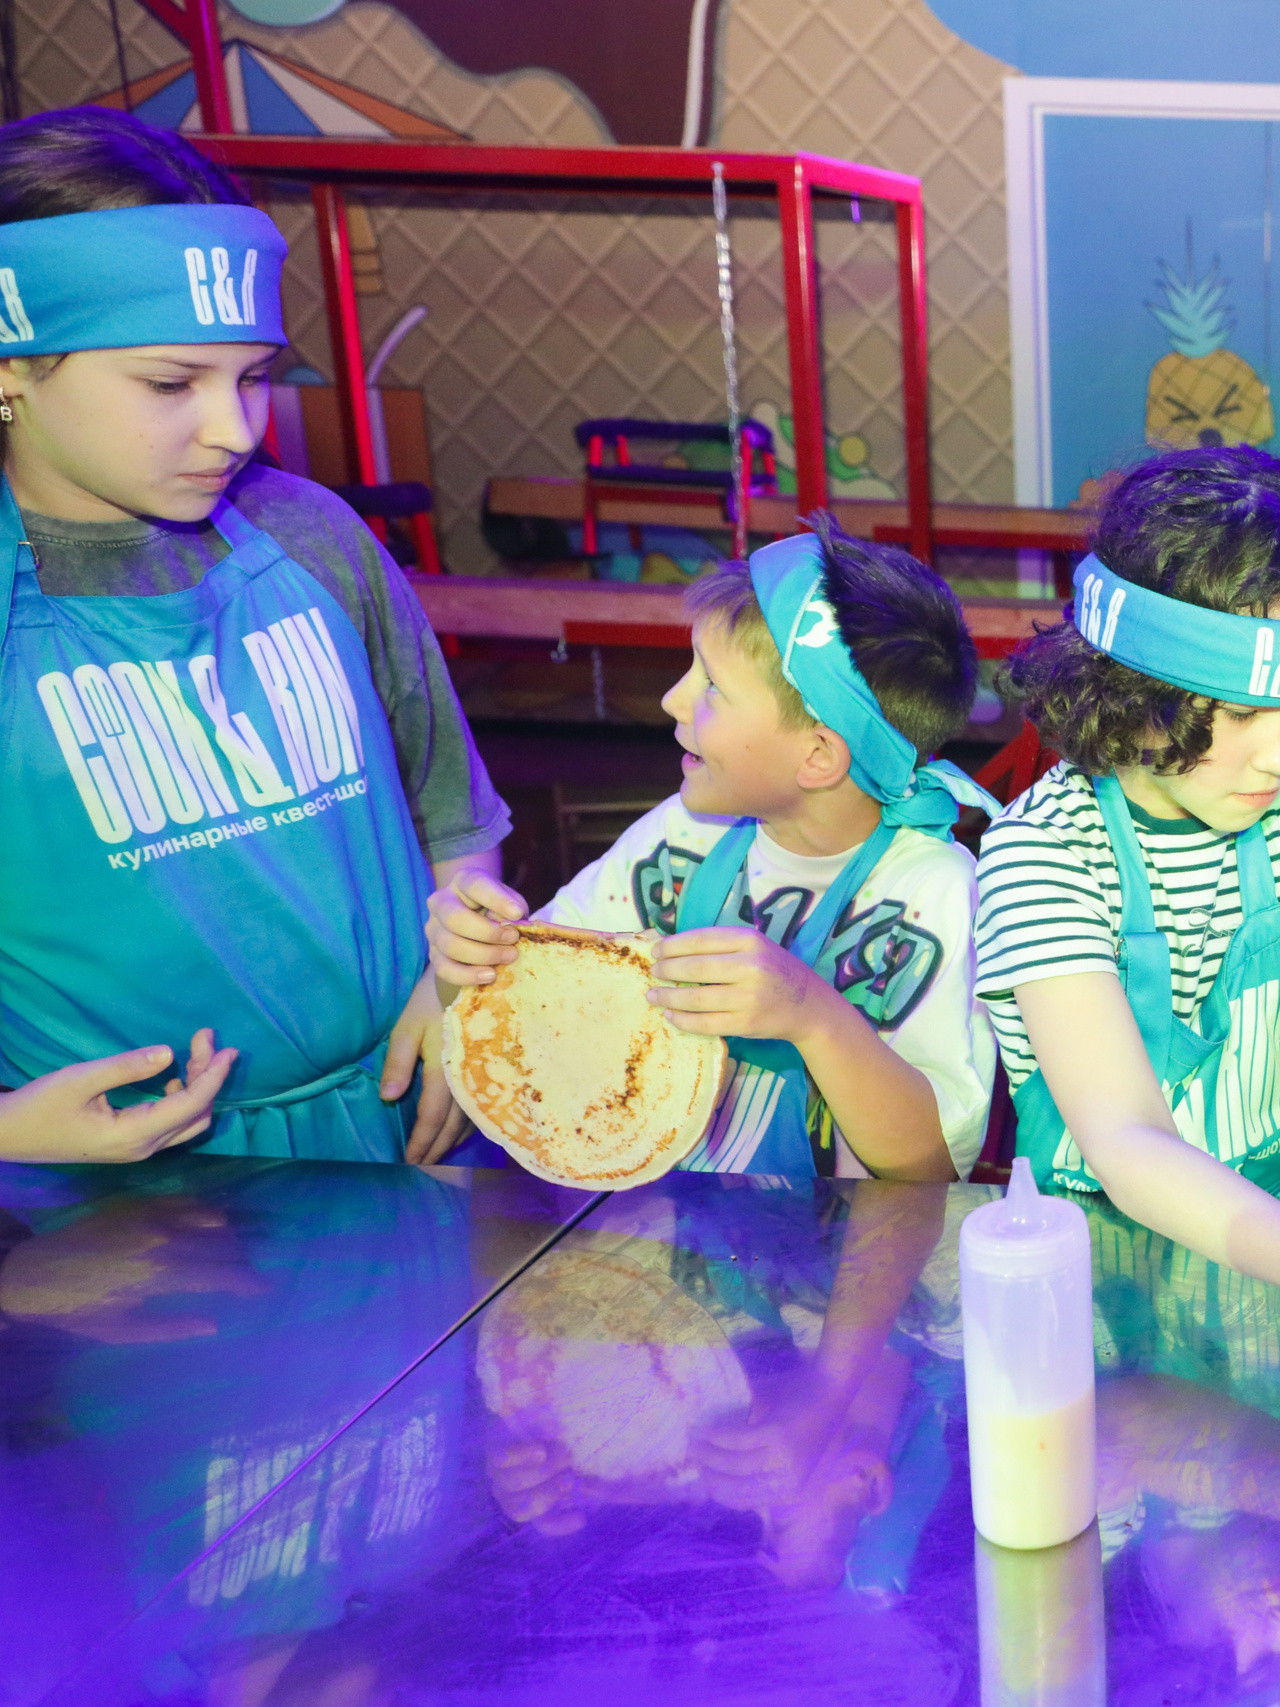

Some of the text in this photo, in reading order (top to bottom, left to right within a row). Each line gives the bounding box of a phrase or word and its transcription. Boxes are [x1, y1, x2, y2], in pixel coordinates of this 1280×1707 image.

[184, 246, 258, 326] C&R
[241, 607, 365, 796] RUN
[107, 774, 369, 871] кулинарные квест-шо
